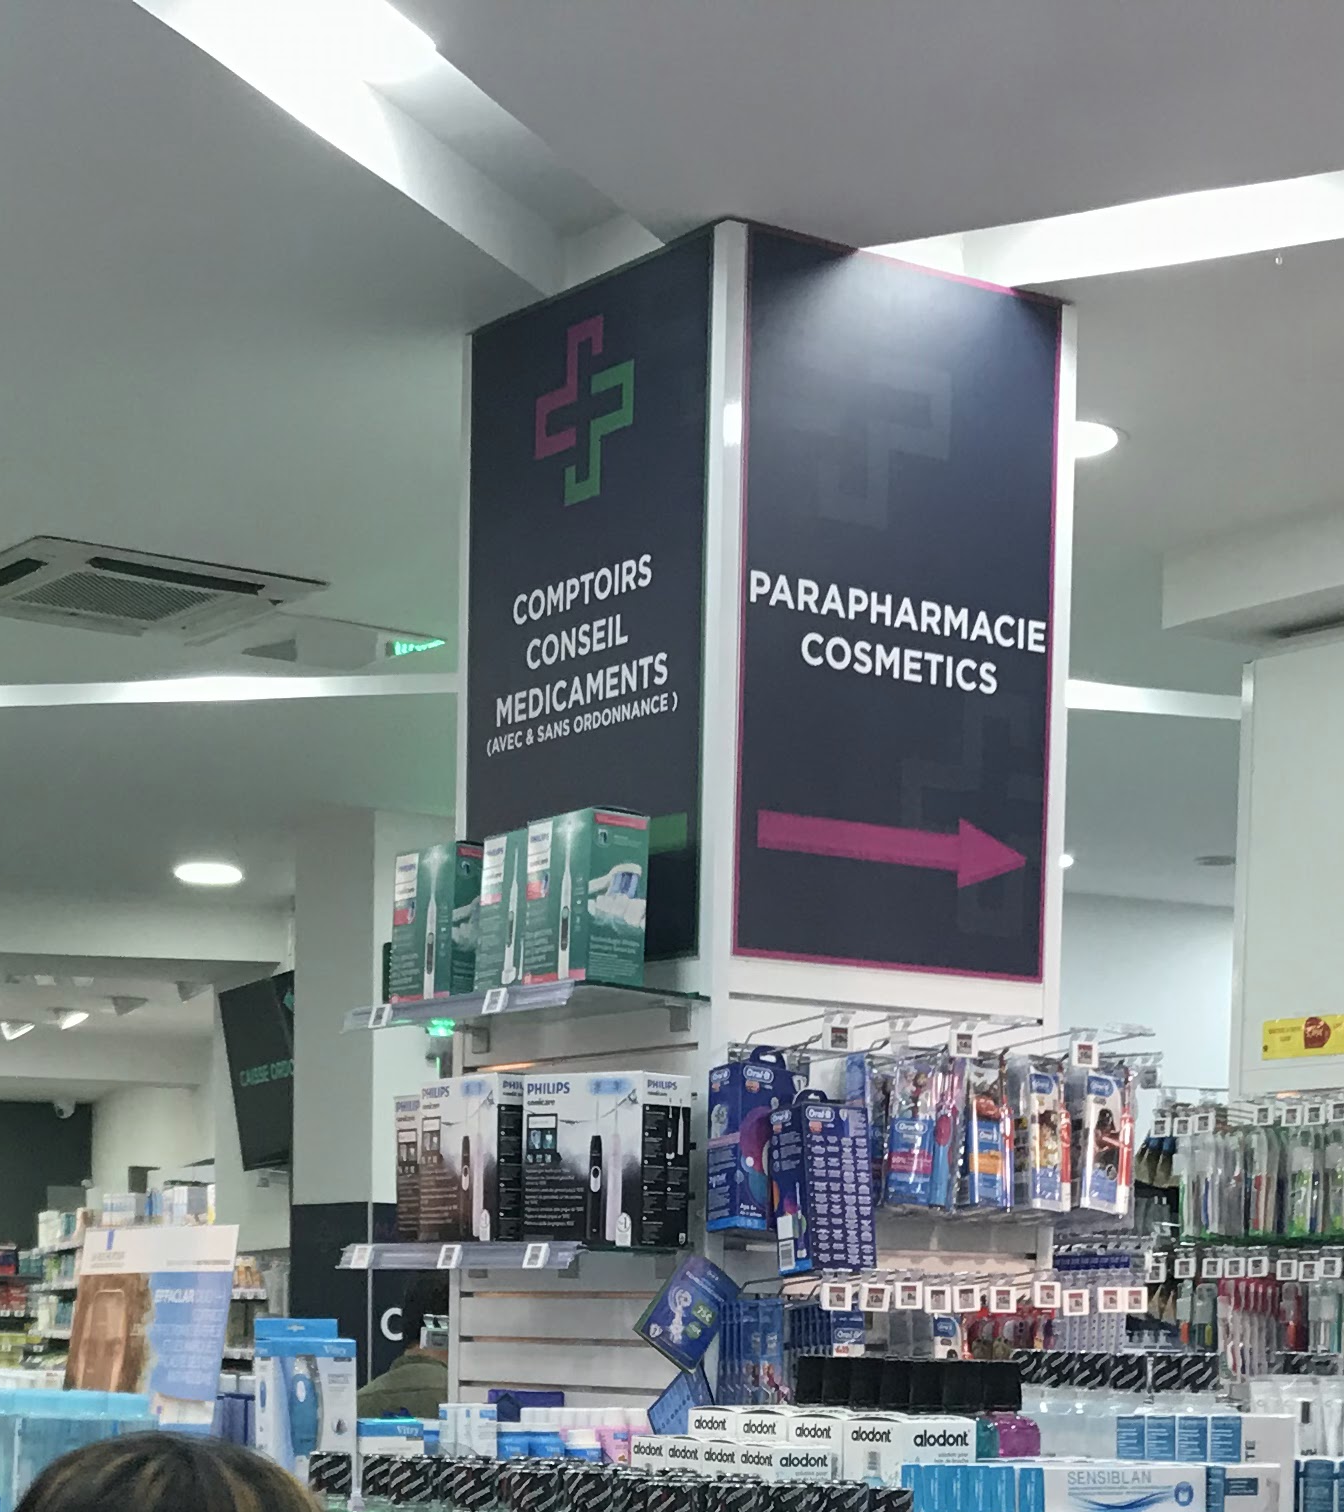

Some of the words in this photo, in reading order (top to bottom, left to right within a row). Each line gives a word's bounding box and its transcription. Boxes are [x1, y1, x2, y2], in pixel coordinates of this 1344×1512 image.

[513, 554, 652, 625] COMPTOIRS
[749, 570, 1047, 654] PARAPHARMACIE
[526, 614, 628, 670] CONSEIL
[801, 631, 997, 696] COSMETICS
[496, 652, 668, 727] MEDICAMENTS
[486, 731, 523, 757] (AVEC
[525, 729, 534, 746] &
[537, 719, 570, 743] SANS
[573, 692, 669, 733] ORDONNANCE
[746, 1068, 771, 1081] Oral-B
[422, 1086, 450, 1099] PHILIPS
[527, 1081, 570, 1096] PHILIPS
[647, 1078, 677, 1091] PHILIPS
[809, 1108, 833, 1119] Oral-B
[694, 1415, 727, 1431] alodont
[743, 1420, 776, 1435] alodont
[795, 1422, 831, 1439] alodont
[851, 1427, 891, 1444] alodont
[914, 1430, 969, 1448] alodont
[633, 1441, 663, 1457] alodont
[668, 1445, 698, 1461] alodont
[704, 1448, 735, 1464] alodont
[741, 1452, 772, 1468] alodont
[780, 1454, 828, 1469] alodont
[1067, 1470, 1151, 1486] SENSIBLAN
